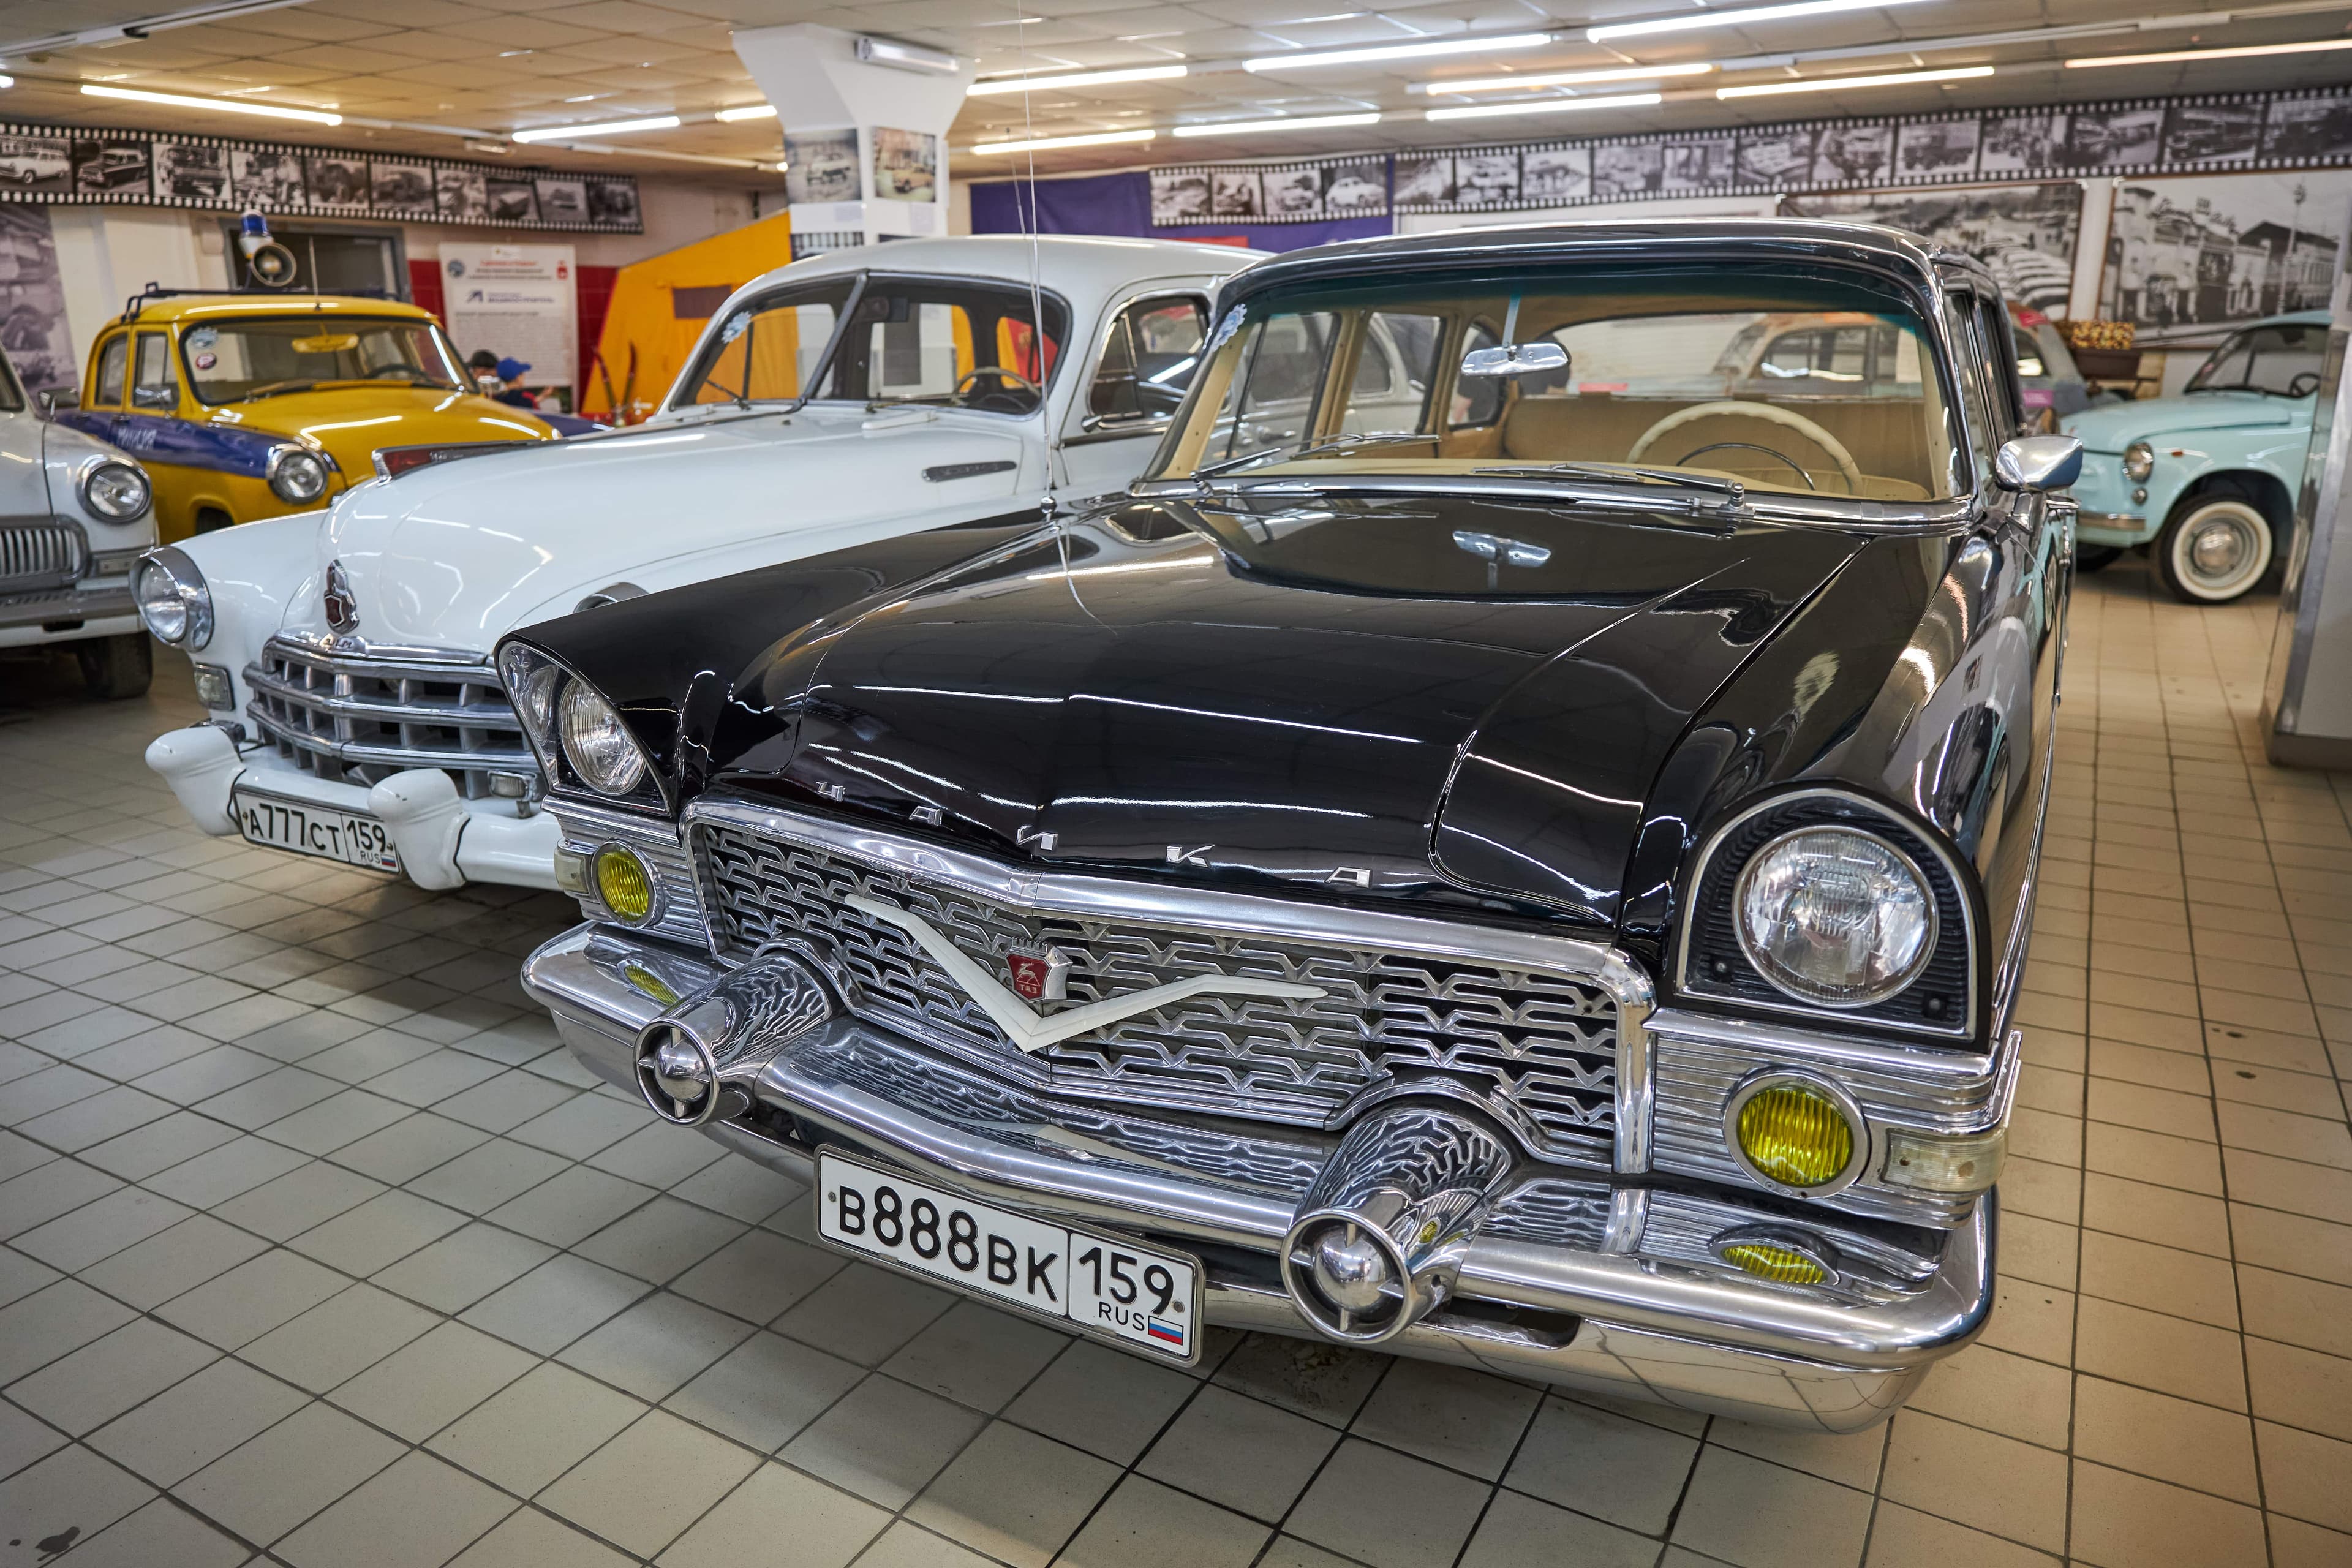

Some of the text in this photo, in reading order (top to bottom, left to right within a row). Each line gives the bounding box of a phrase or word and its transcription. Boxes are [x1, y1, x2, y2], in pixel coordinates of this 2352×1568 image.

[249, 803, 386, 854] А777СТ 159
[360, 850, 381, 864] RUS
[1019, 983, 1037, 993] ГАЗ
[839, 1185, 1175, 1315] В888ВК 159
[1098, 1300, 1145, 1332] RUS
